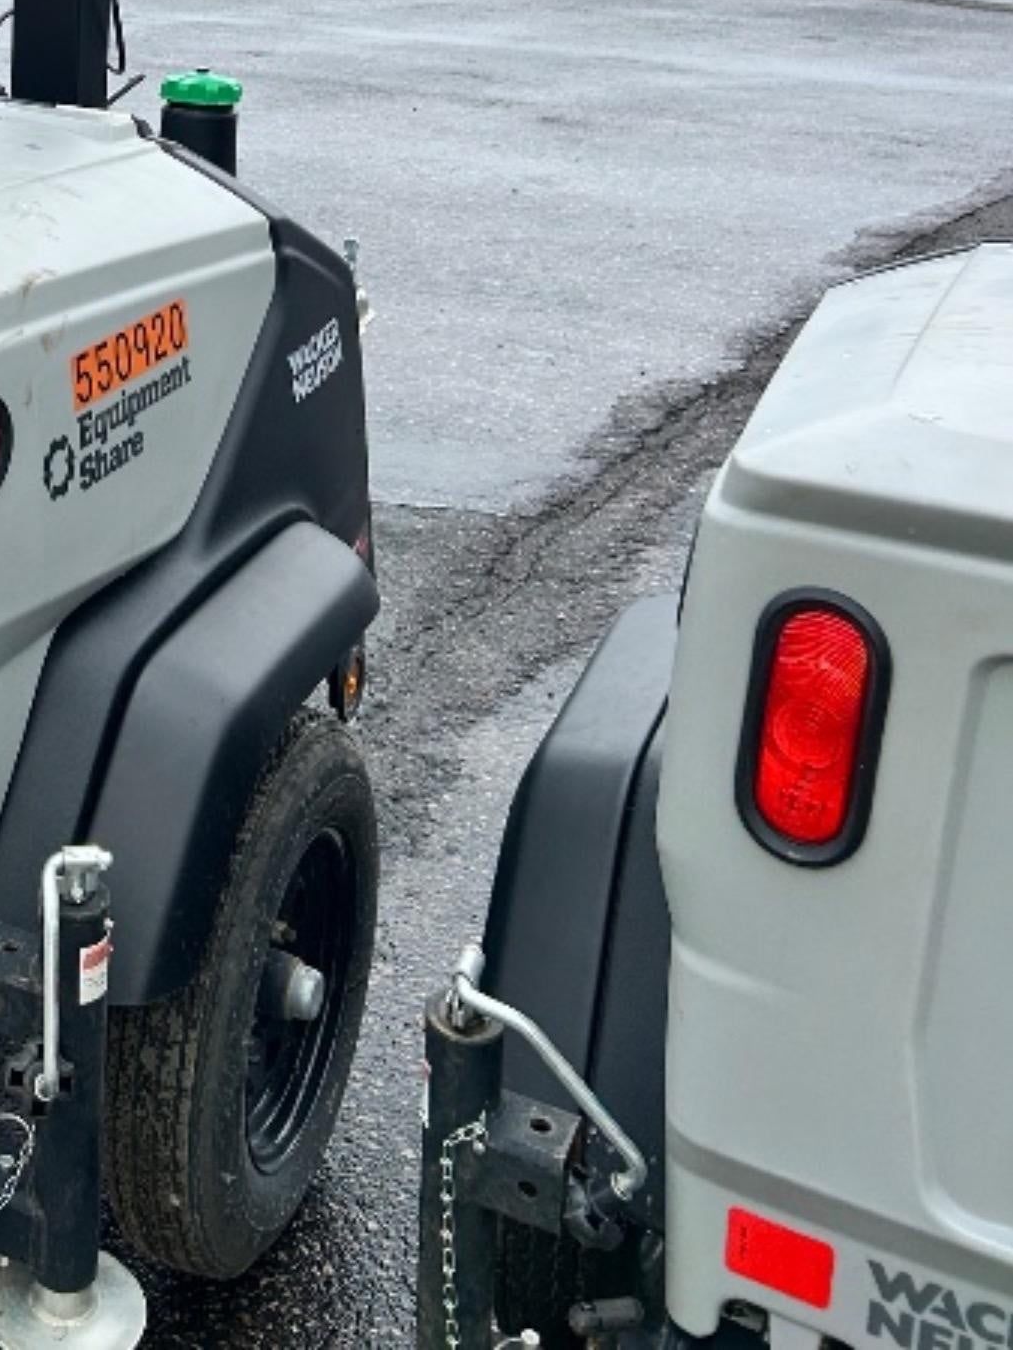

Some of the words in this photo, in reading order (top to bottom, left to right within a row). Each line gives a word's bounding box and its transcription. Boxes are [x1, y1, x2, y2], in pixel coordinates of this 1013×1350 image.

[75, 302, 185, 404] 550920
[286, 317, 340, 377] WACKER
[292, 338, 343, 404] NEUSON
[77, 356, 192, 450] Equipment
[79, 431, 145, 491] Share
[867, 1259, 1013, 1350] WAC
